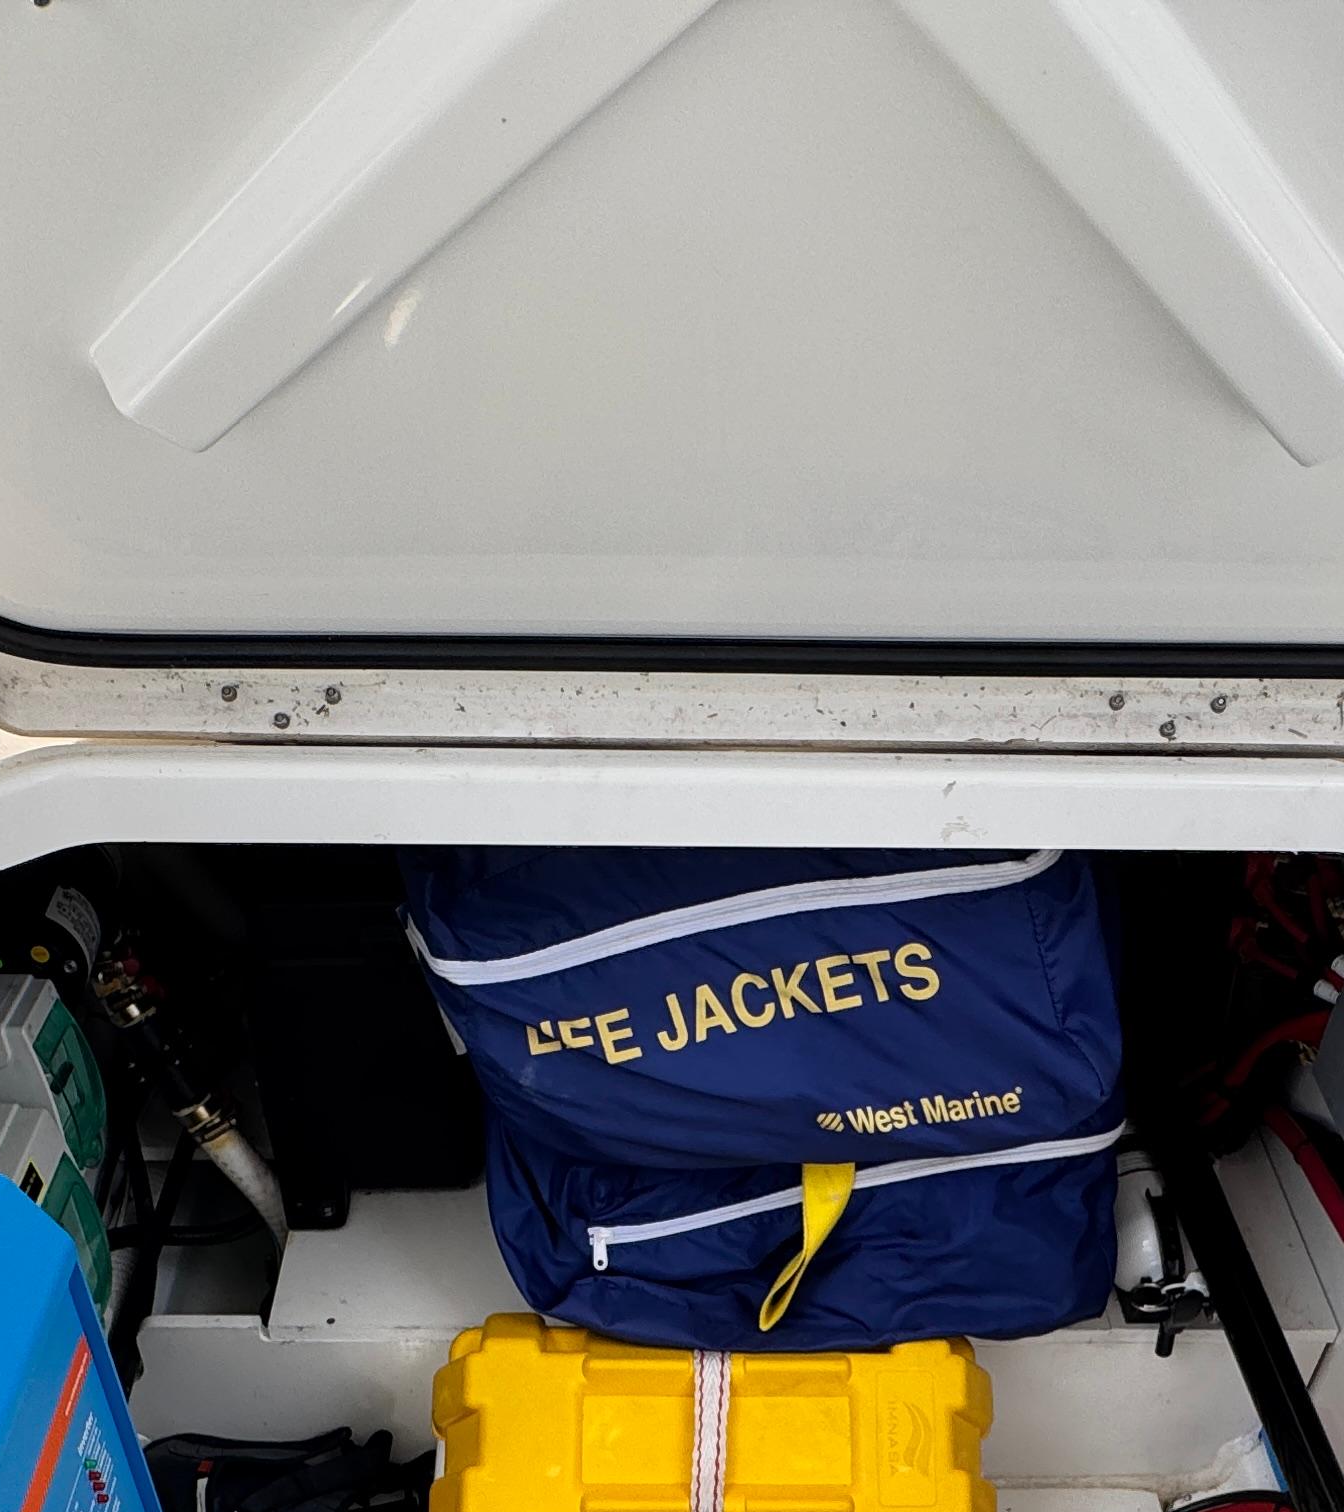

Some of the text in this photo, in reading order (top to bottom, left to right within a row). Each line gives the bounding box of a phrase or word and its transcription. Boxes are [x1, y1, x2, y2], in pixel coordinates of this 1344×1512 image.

[657, 942, 942, 1052] JACKETS
[845, 1089, 1022, 1135] West Marine
